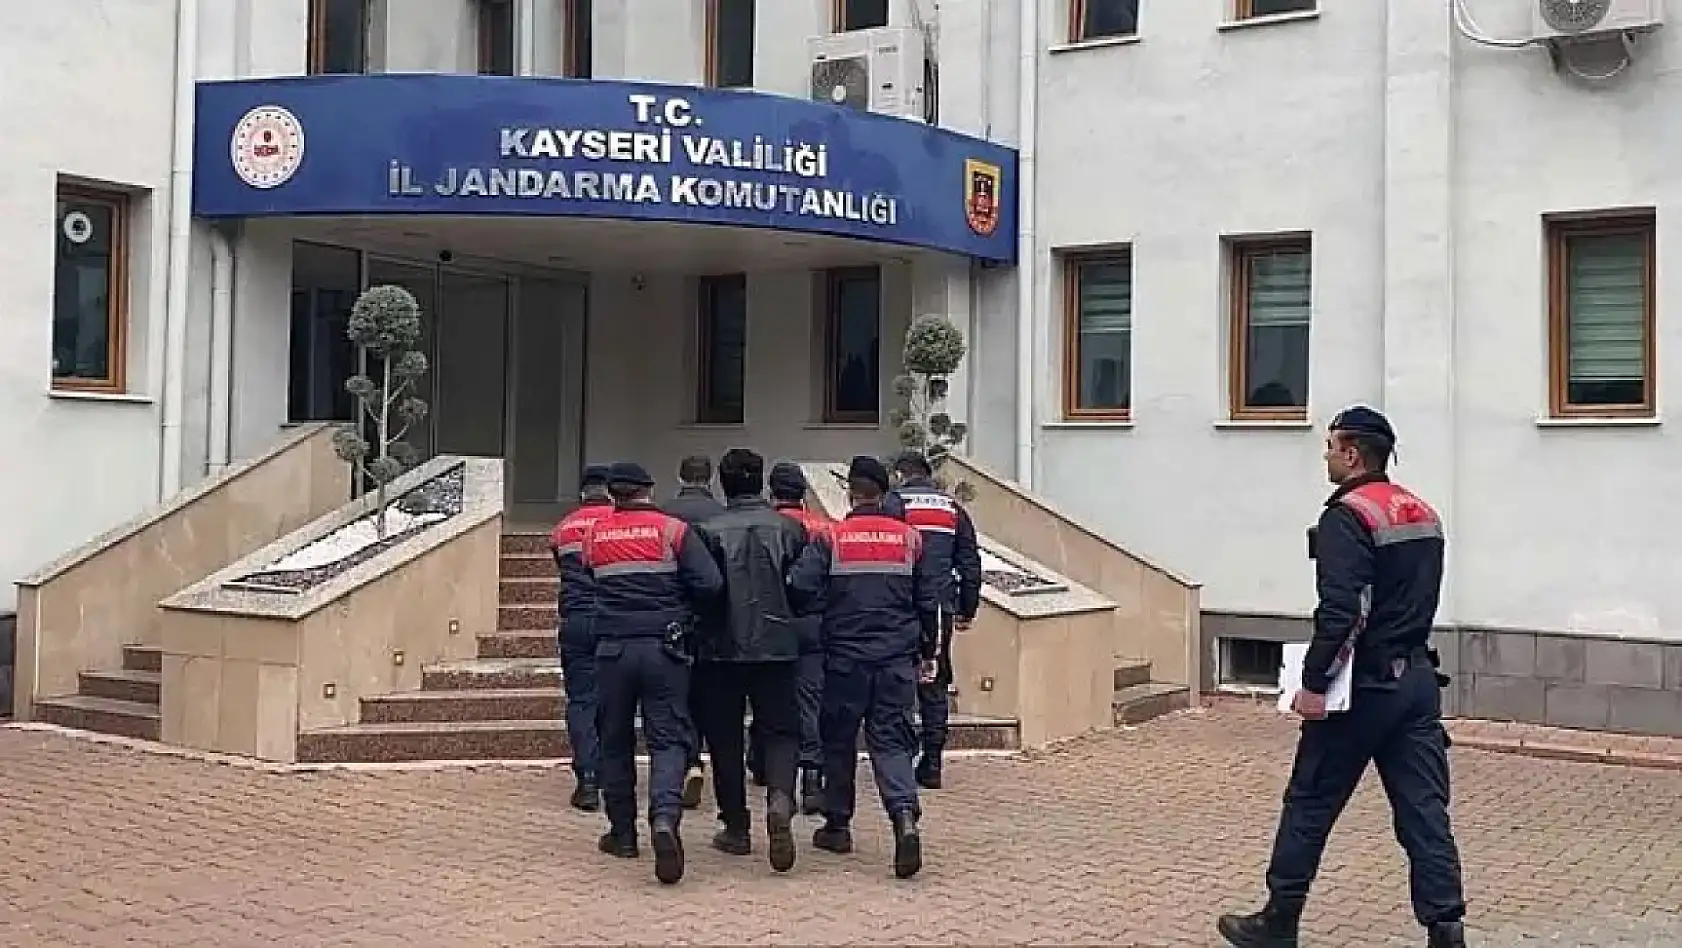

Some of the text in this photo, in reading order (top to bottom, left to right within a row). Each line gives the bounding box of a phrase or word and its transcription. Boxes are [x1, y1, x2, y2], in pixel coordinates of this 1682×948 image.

[630, 94, 701, 127] T.C.
[500, 127, 828, 177] KAYSERİ VALİLİĞİ
[388, 158, 897, 225] İL JANDARMA KOMUTANLIĞI
